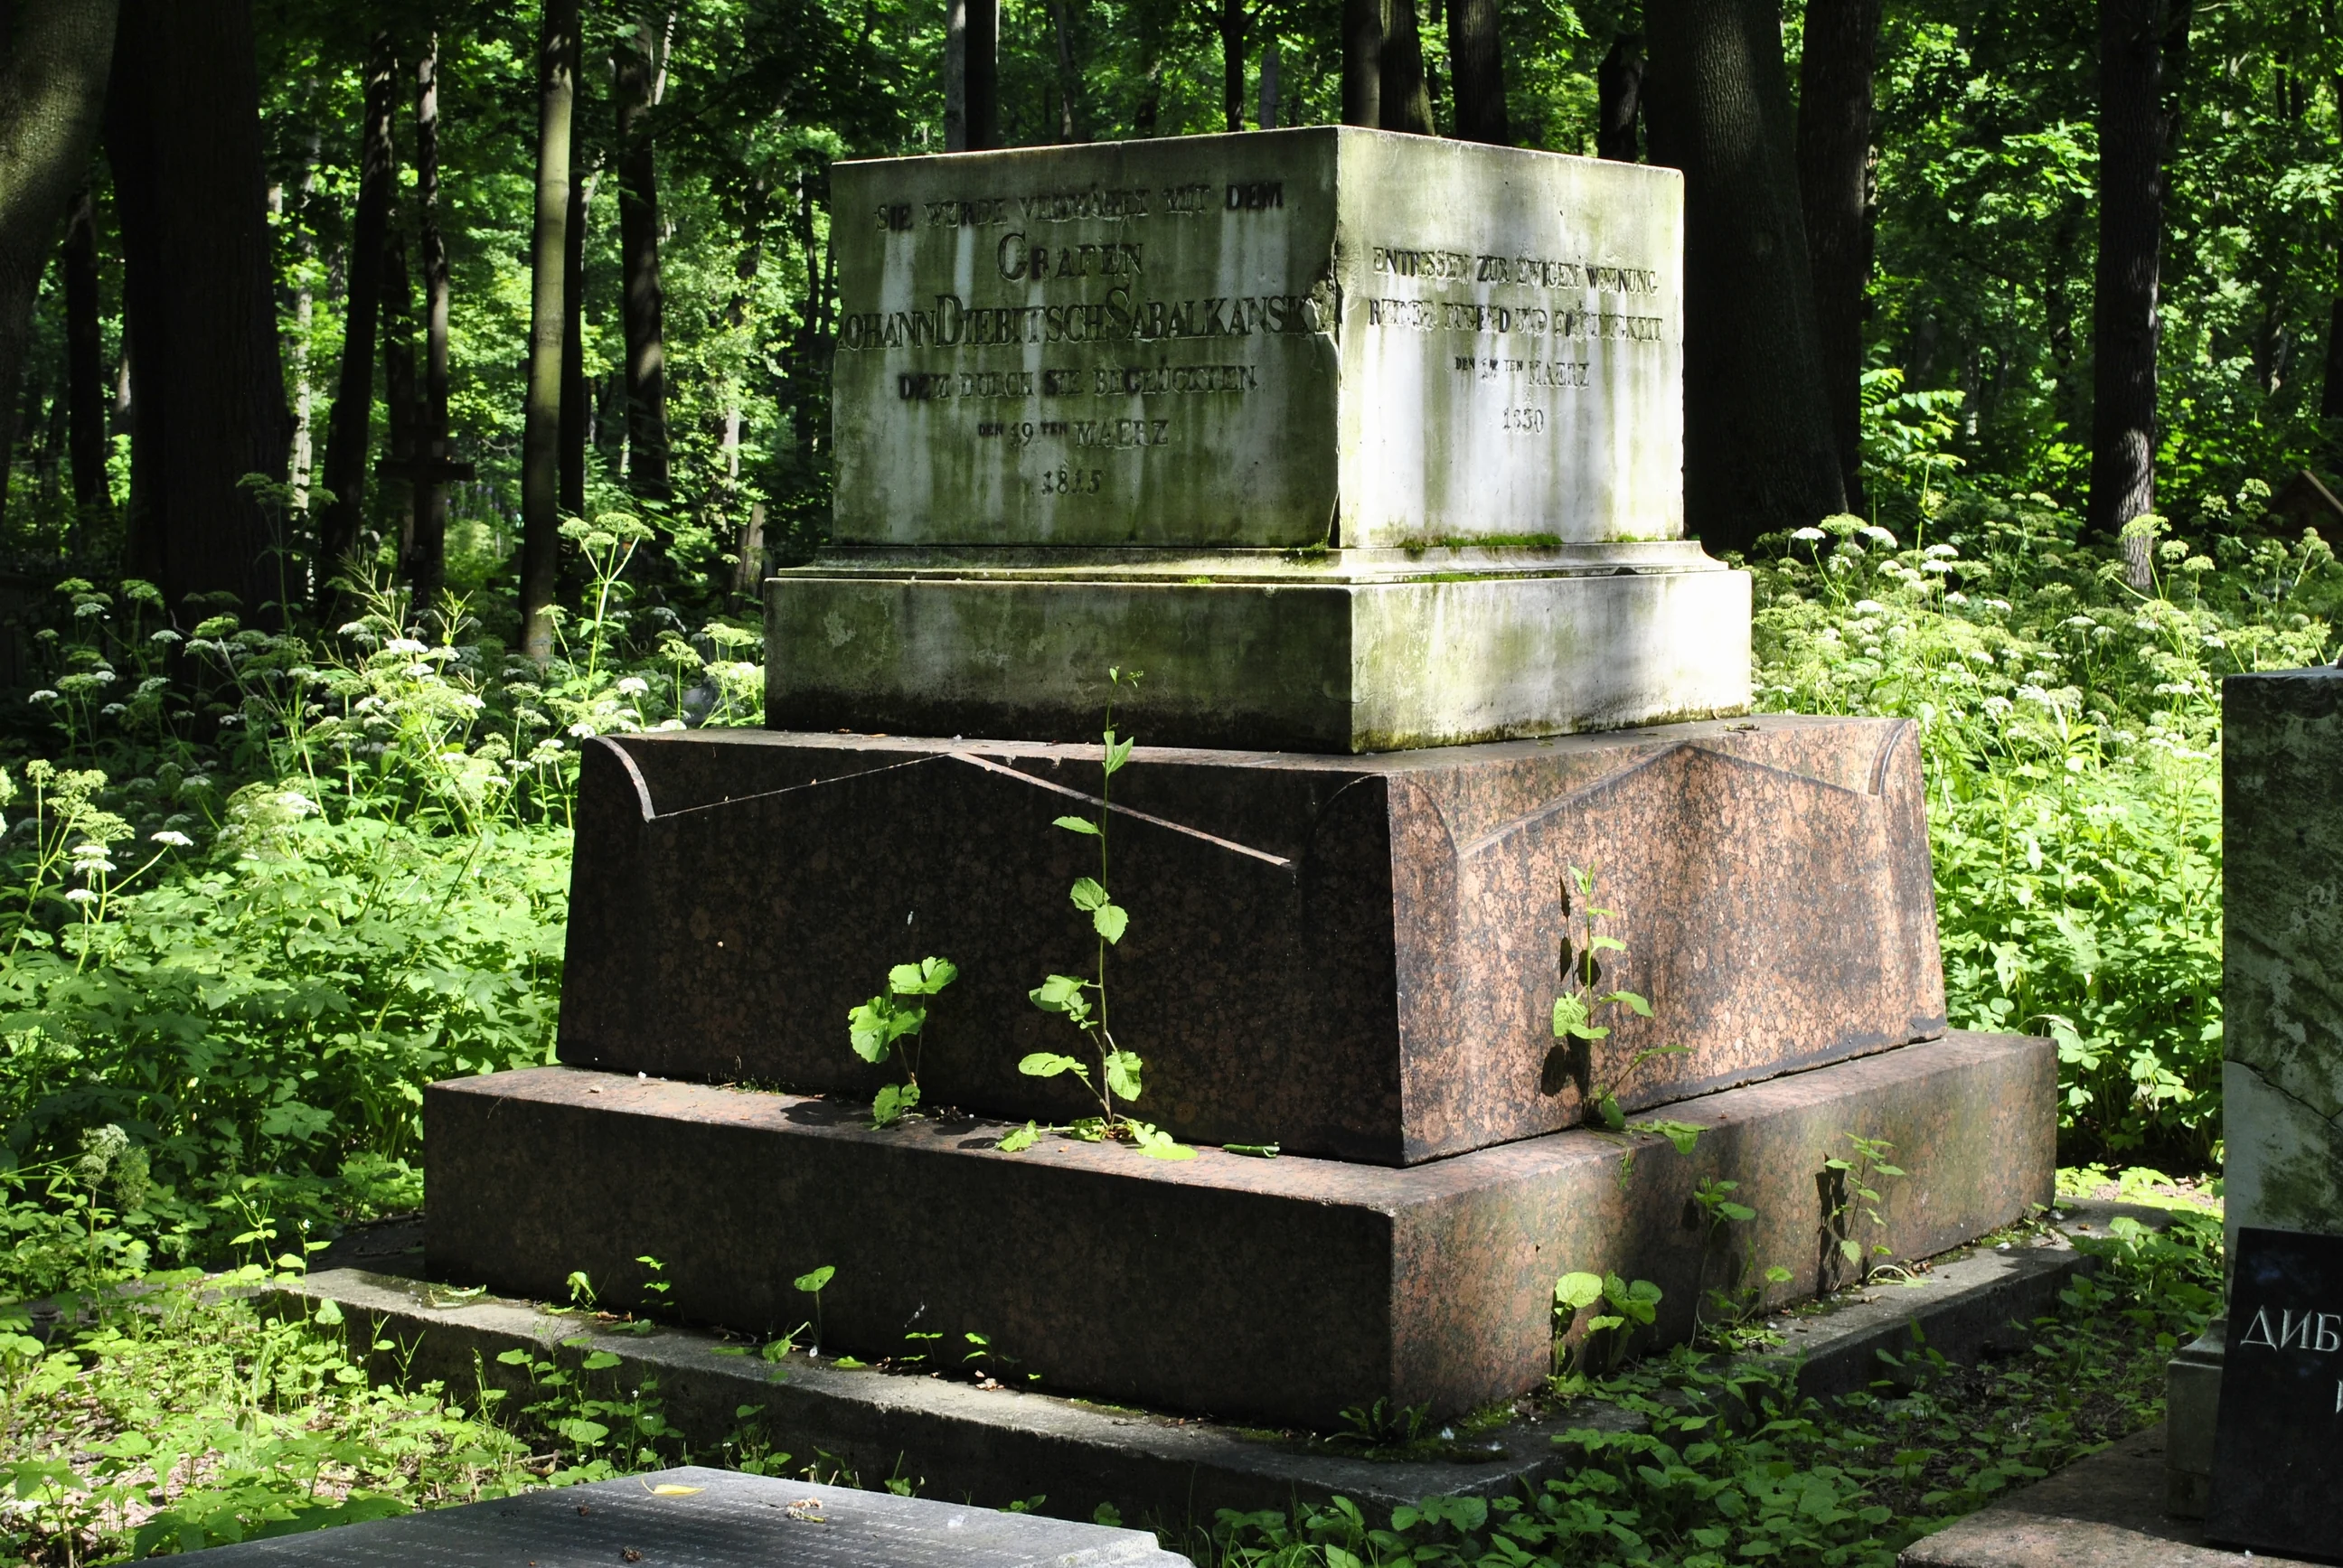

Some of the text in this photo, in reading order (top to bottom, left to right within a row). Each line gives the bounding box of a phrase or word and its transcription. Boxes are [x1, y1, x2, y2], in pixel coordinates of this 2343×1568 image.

[875, 202, 913, 231] SIE
[923, 199, 1008, 227] WURDE
[1162, 183, 1210, 214] MIT
[1226, 183, 1284, 211] DEM
[997, 231, 1143, 281] GRAFEN
[1477, 255, 1510, 283] ZUR
[1586, 264, 1659, 296] WOHNUNG
[838, 304, 936, 350] OHANN
[959, 371, 1033, 398] DURCH
[1043, 369, 1083, 396] SIE
[1455, 357, 1475, 371] DEN
[1504, 359, 1523, 371] TEN
[1529, 360, 1590, 390] MAERZ
[978, 422, 1003, 436] DEN
[1040, 421, 1068, 435] TEN
[1077, 419, 1169, 448] MAERZ
[1041, 469, 1103, 495] 1815
